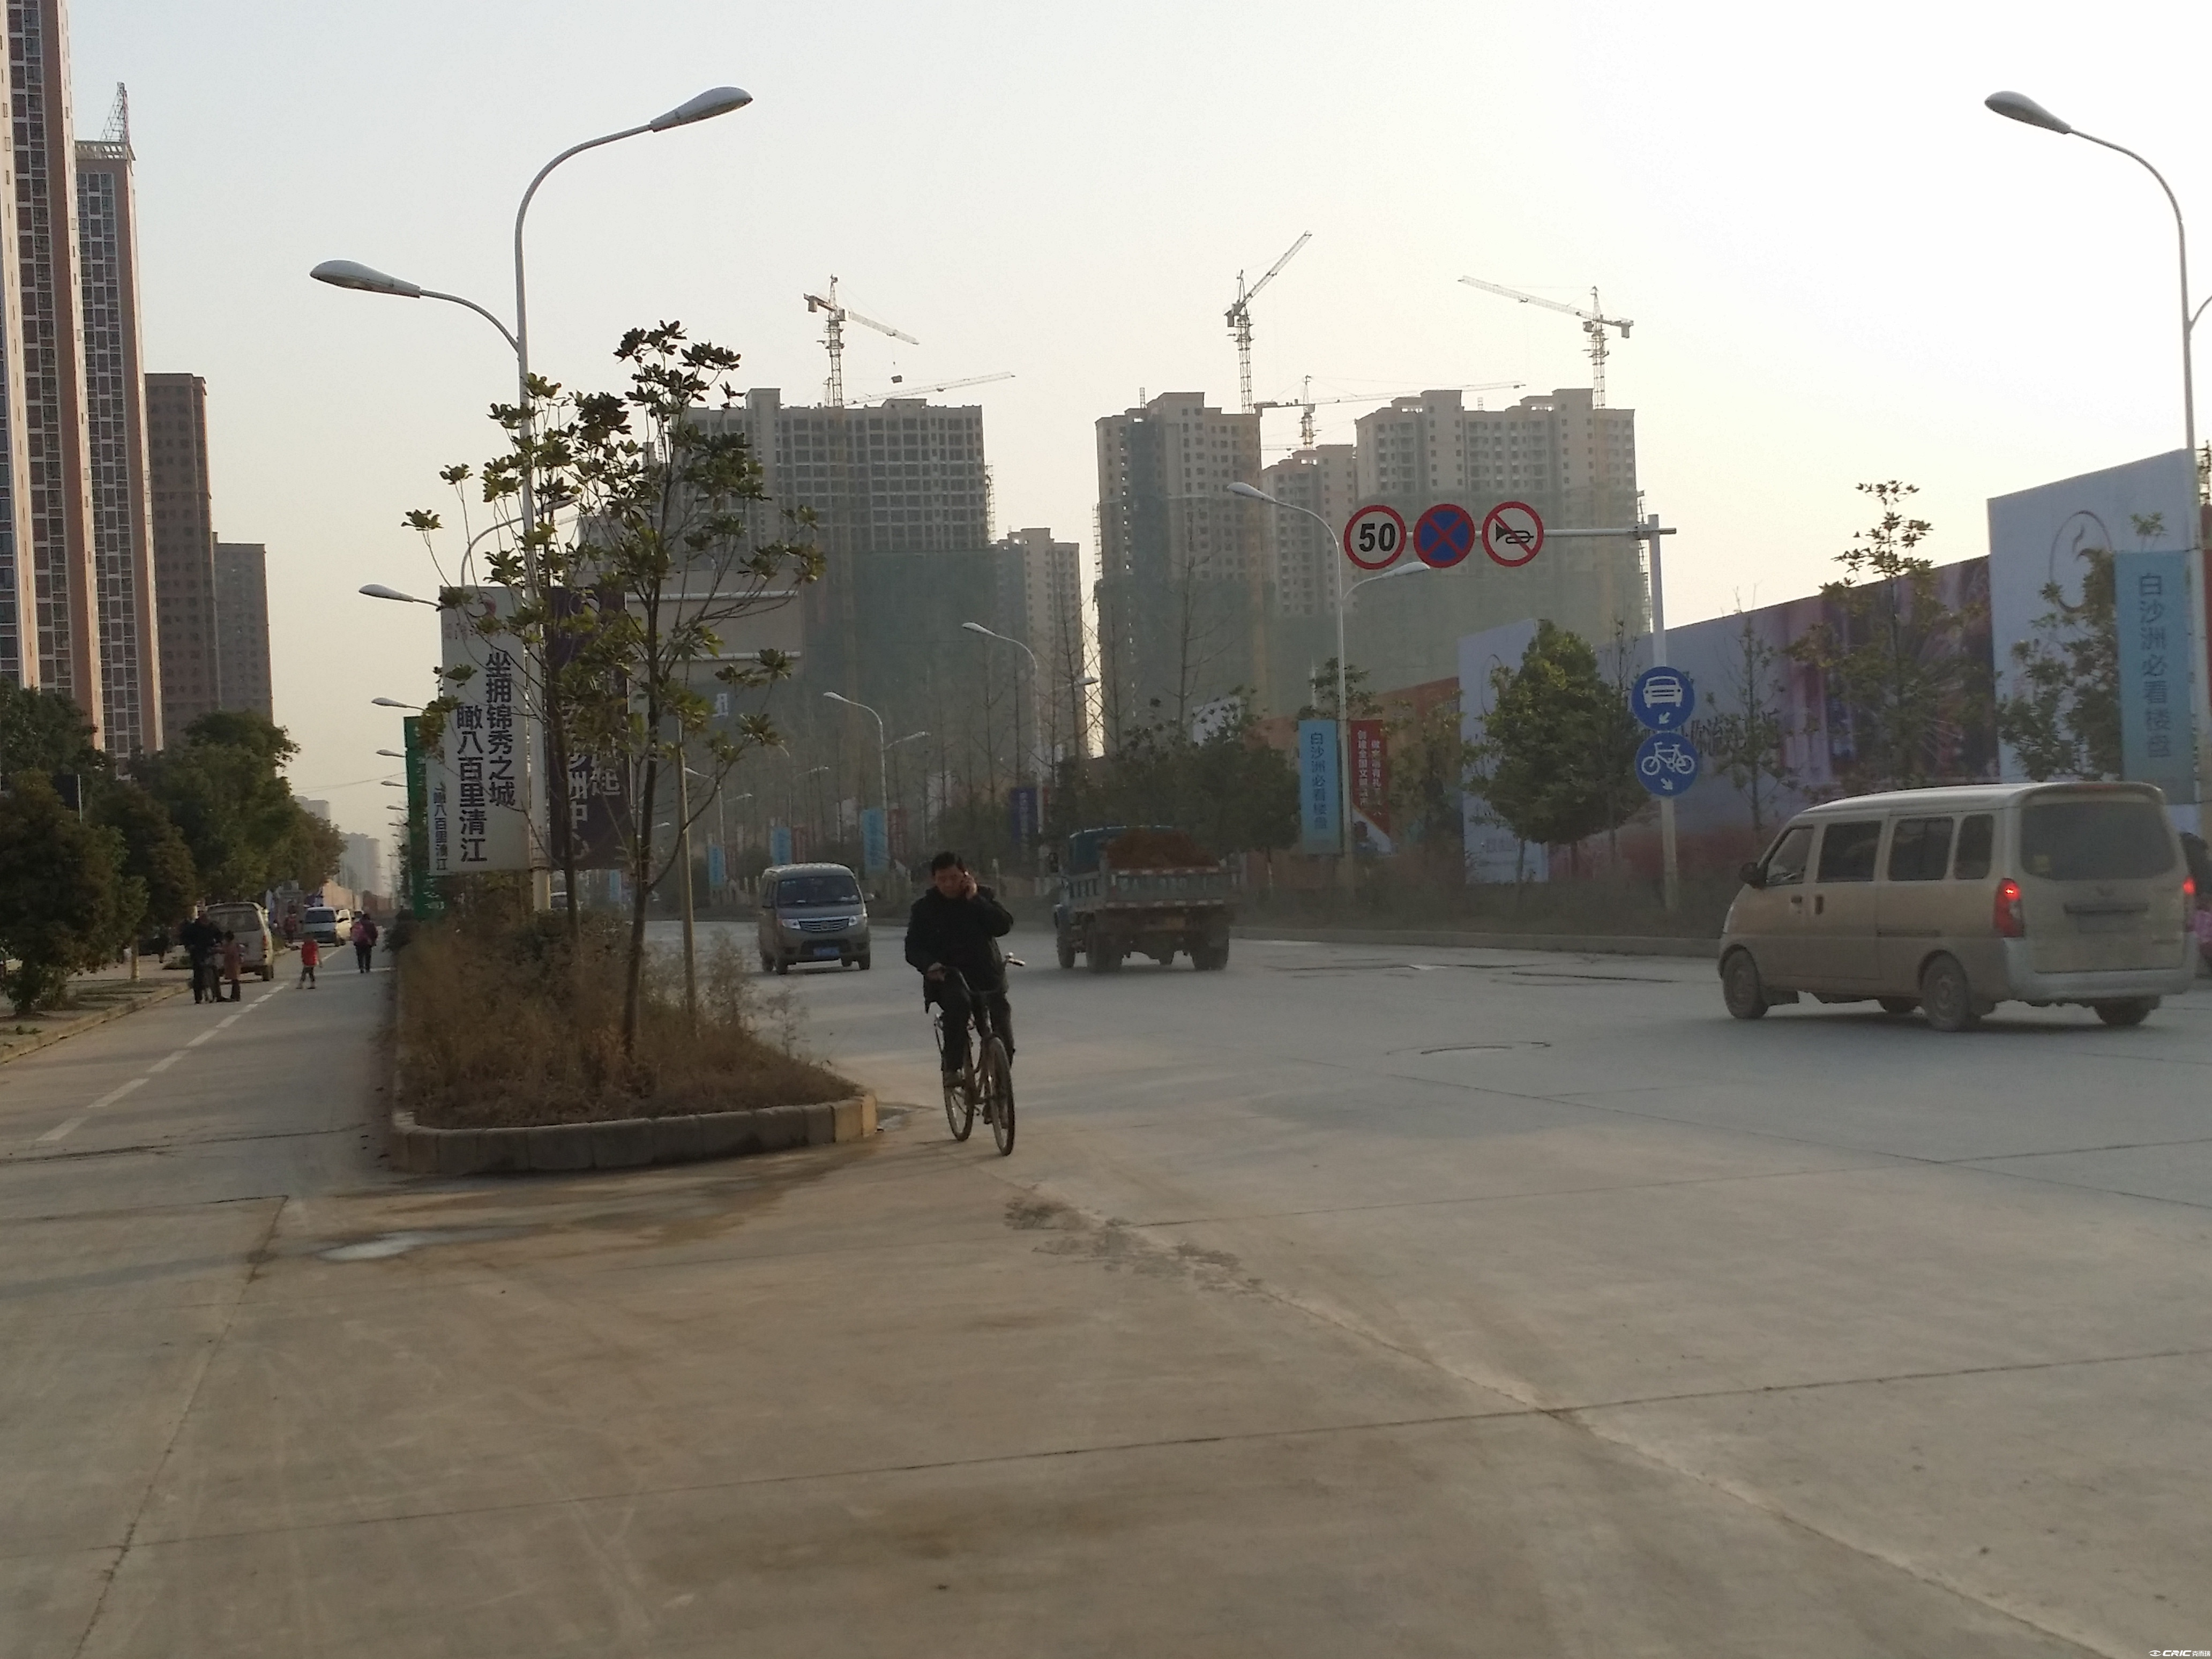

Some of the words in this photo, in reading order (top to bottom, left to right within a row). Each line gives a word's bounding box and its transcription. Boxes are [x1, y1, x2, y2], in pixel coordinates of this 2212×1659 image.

[1359, 523, 1396, 552] 50
[457, 705, 487, 862] 瞰八百里清江
[486, 652, 515, 806] 坐拥锦秀之城
